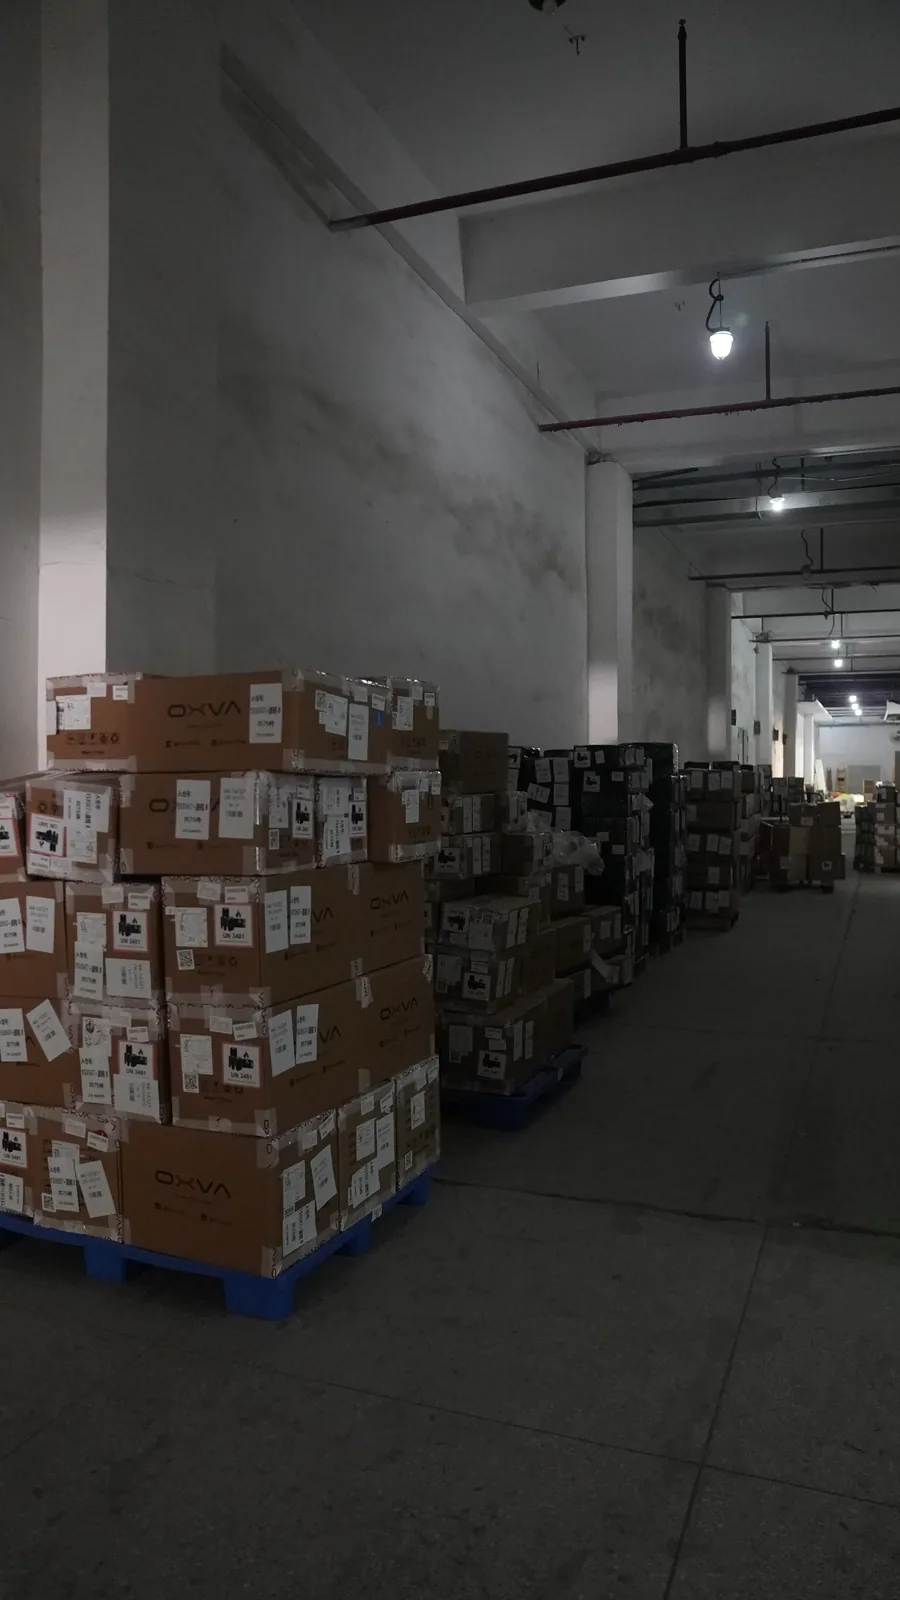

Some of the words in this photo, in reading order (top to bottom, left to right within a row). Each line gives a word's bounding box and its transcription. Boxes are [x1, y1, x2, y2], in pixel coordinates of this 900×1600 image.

[167, 700, 241, 718] OXVA
[370, 890, 410, 910] OXVA
[312, 907, 334, 923] VA
[380, 996, 419, 1021] OXVA
[319, 1025, 341, 1044] VA
[154, 1169, 231, 1198] OXVA
